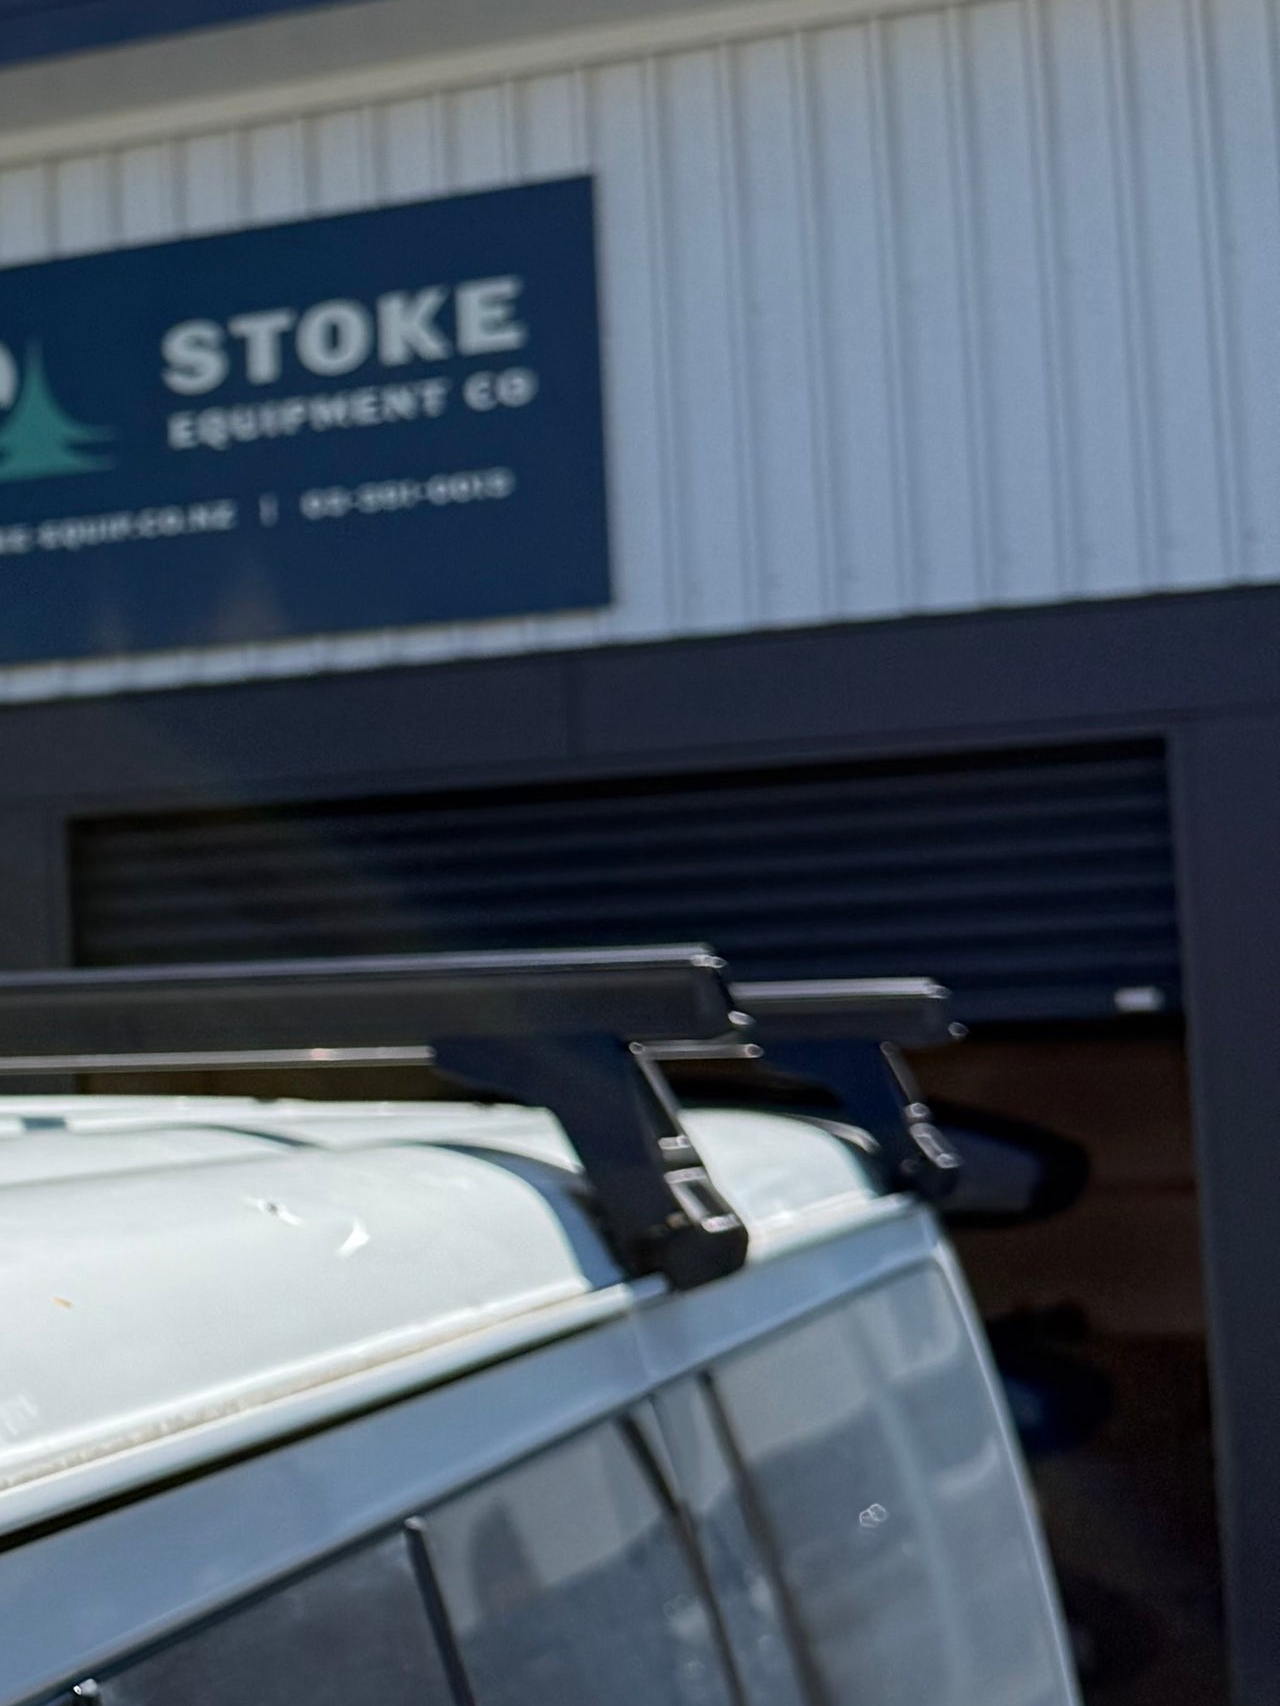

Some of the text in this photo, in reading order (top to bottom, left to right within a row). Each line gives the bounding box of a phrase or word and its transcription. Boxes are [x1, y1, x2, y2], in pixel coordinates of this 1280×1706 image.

[162, 275, 529, 395] STOKE
[167, 366, 538, 450] EQUIPMENT CO
